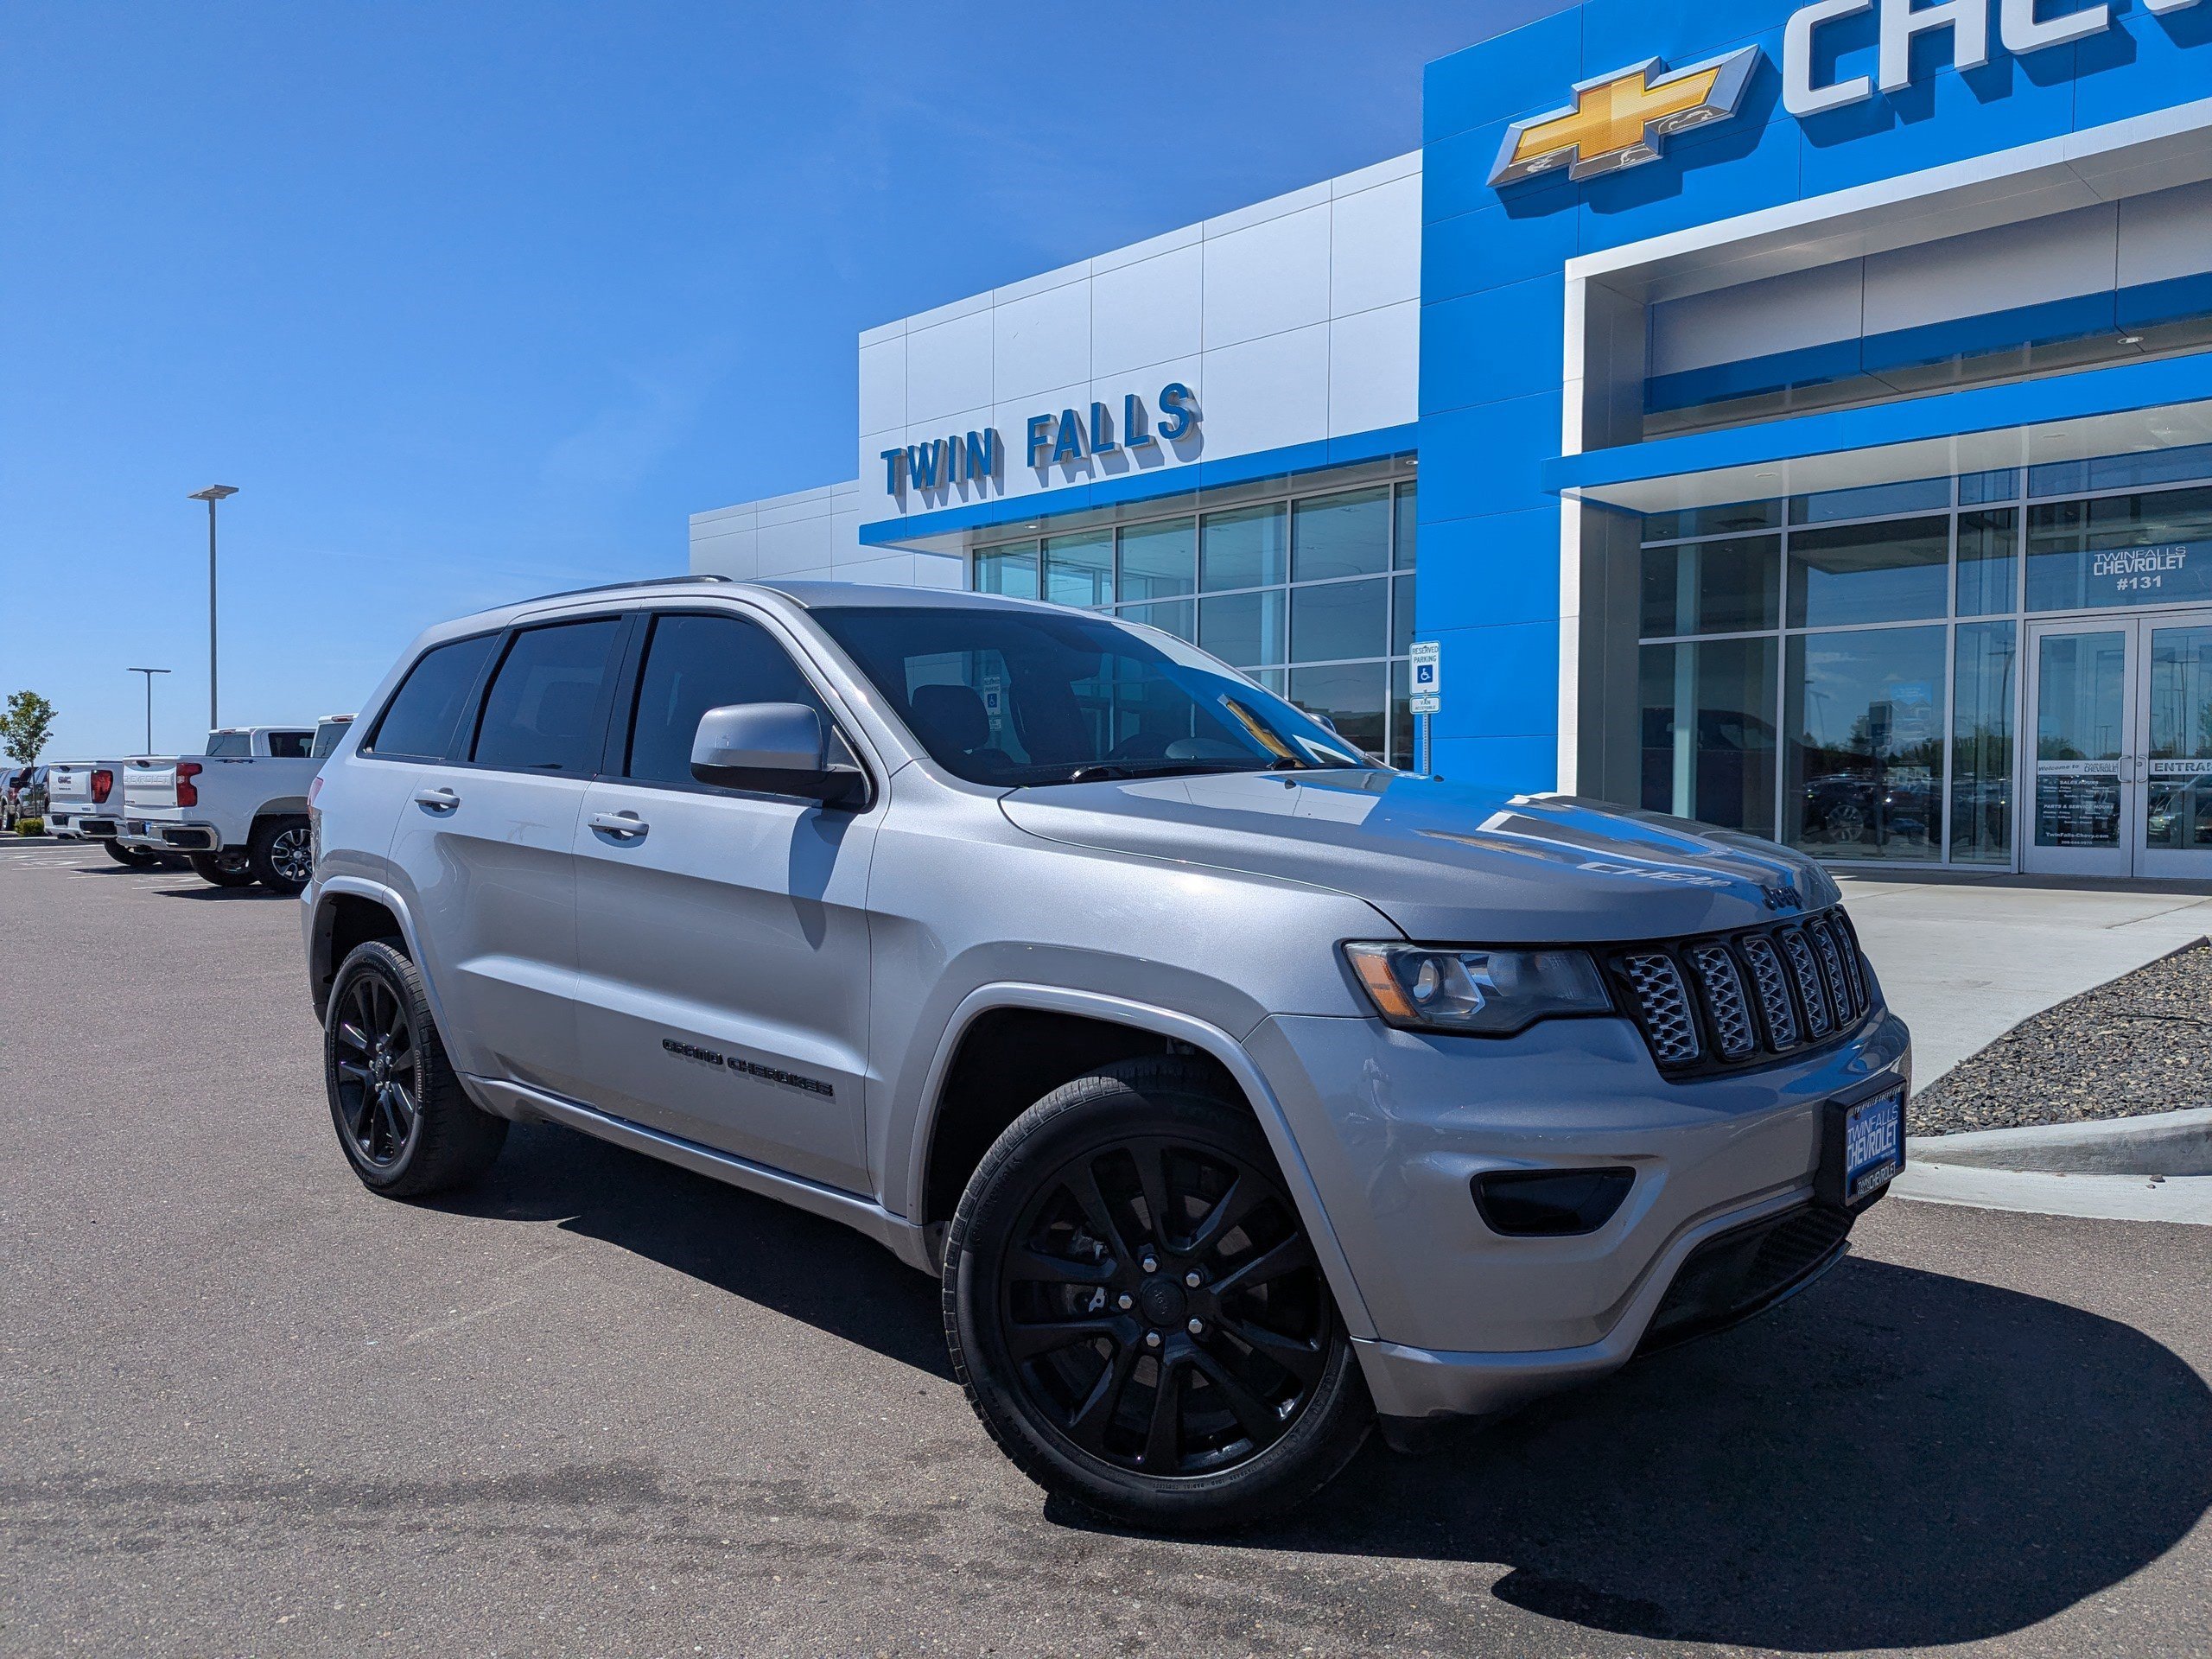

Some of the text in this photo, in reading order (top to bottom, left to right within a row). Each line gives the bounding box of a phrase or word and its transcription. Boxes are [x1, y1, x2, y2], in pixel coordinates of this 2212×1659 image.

[880, 383, 1195, 498] TWIN FALLS
[2094, 546, 2186, 563] TWINFALLS
[2094, 555, 2186, 576] CHEVROLET
[2117, 575, 2162, 591] #131
[1412, 645, 1439, 655] RESERVED
[1414, 655, 1437, 664] PARKING
[1760, 884, 1802, 912] Jeep
[662, 1038, 834, 1097] GRAND CHEROKEE
[1847, 1119, 1898, 1172] CHEVROLET
[1869, 1160, 1897, 1190] CHEVROLET
